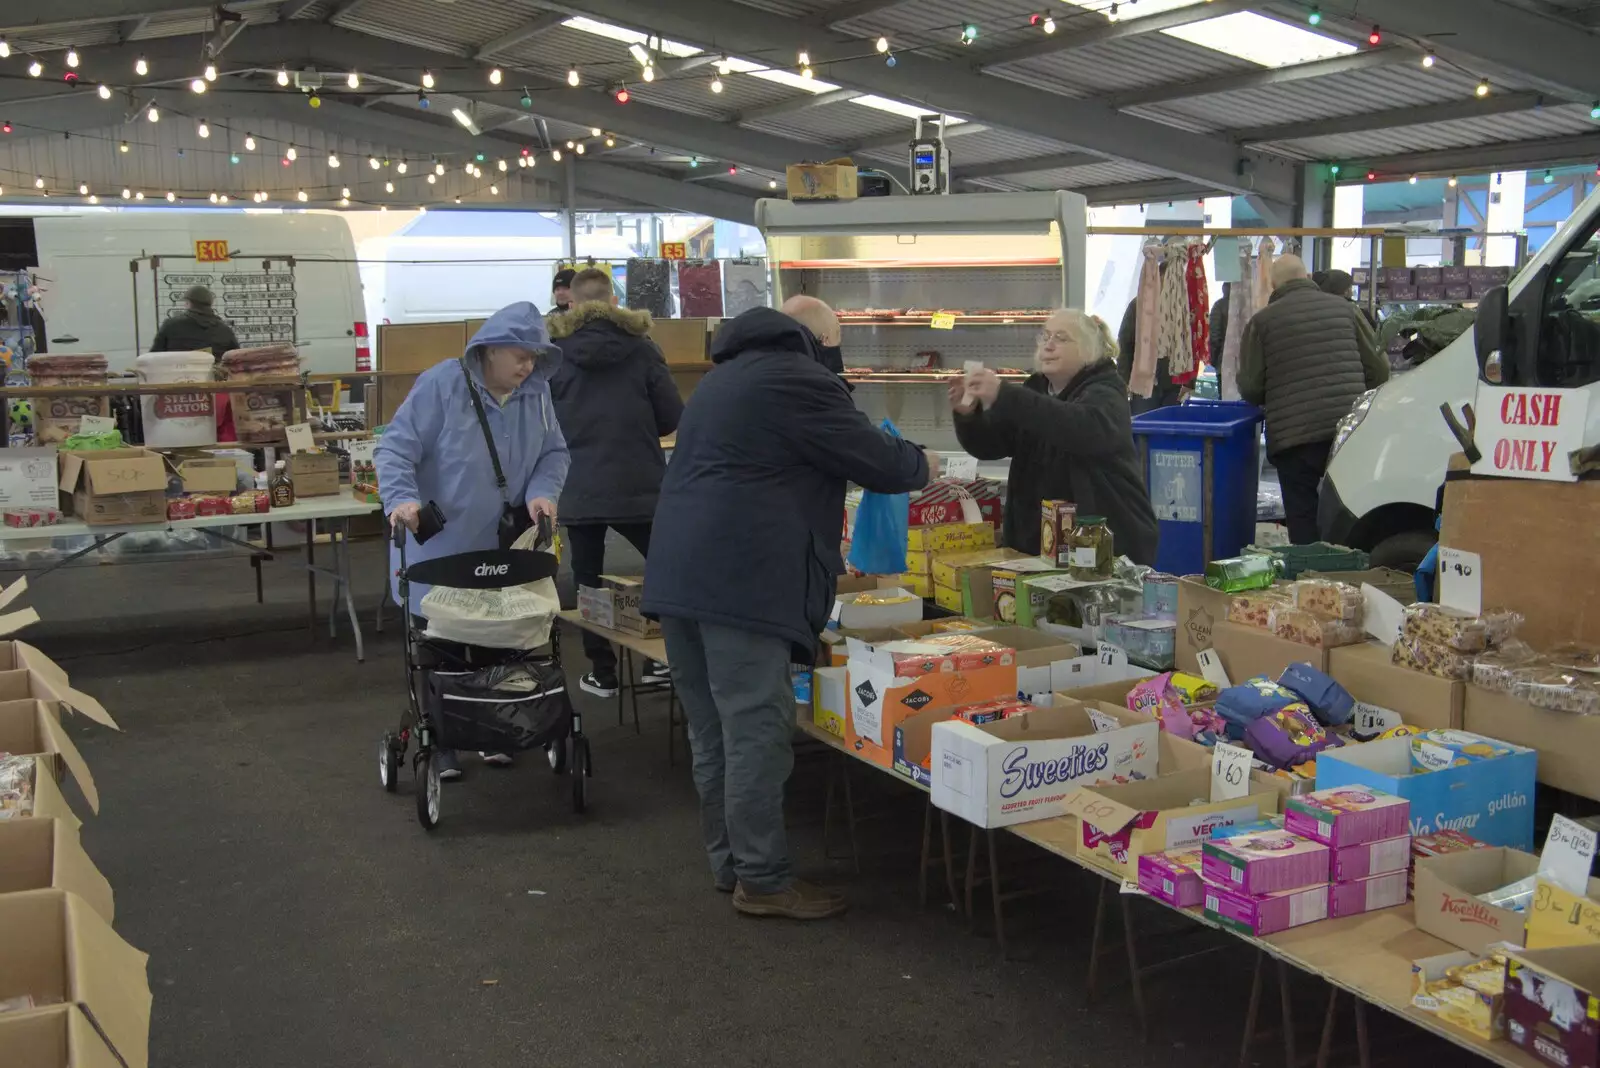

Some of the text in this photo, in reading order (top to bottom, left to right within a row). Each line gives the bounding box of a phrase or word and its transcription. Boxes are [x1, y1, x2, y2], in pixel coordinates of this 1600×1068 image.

[199, 242, 227, 259] £10
[664, 244, 684, 259] £5
[163, 393, 209, 403] STELLA
[163, 402, 209, 413] ARTOIS
[1500, 393, 1562, 426] CASH
[1155, 453, 1195, 468] LITTER
[1493, 438, 1557, 472] ONLY
[474, 562, 508, 576] drive
[1190, 622, 1212, 636] CLEAN
[1000, 742, 1109, 799] Sweeties
[1001, 800, 1028, 811] ASSORTED
[1028, 798, 1043, 807] FRUIT
[1488, 791, 1527, 816] gullón
[1435, 812, 1481, 831] Sugar
[1551, 826, 1561, 841] 3
[1534, 884, 1552, 911] 3
